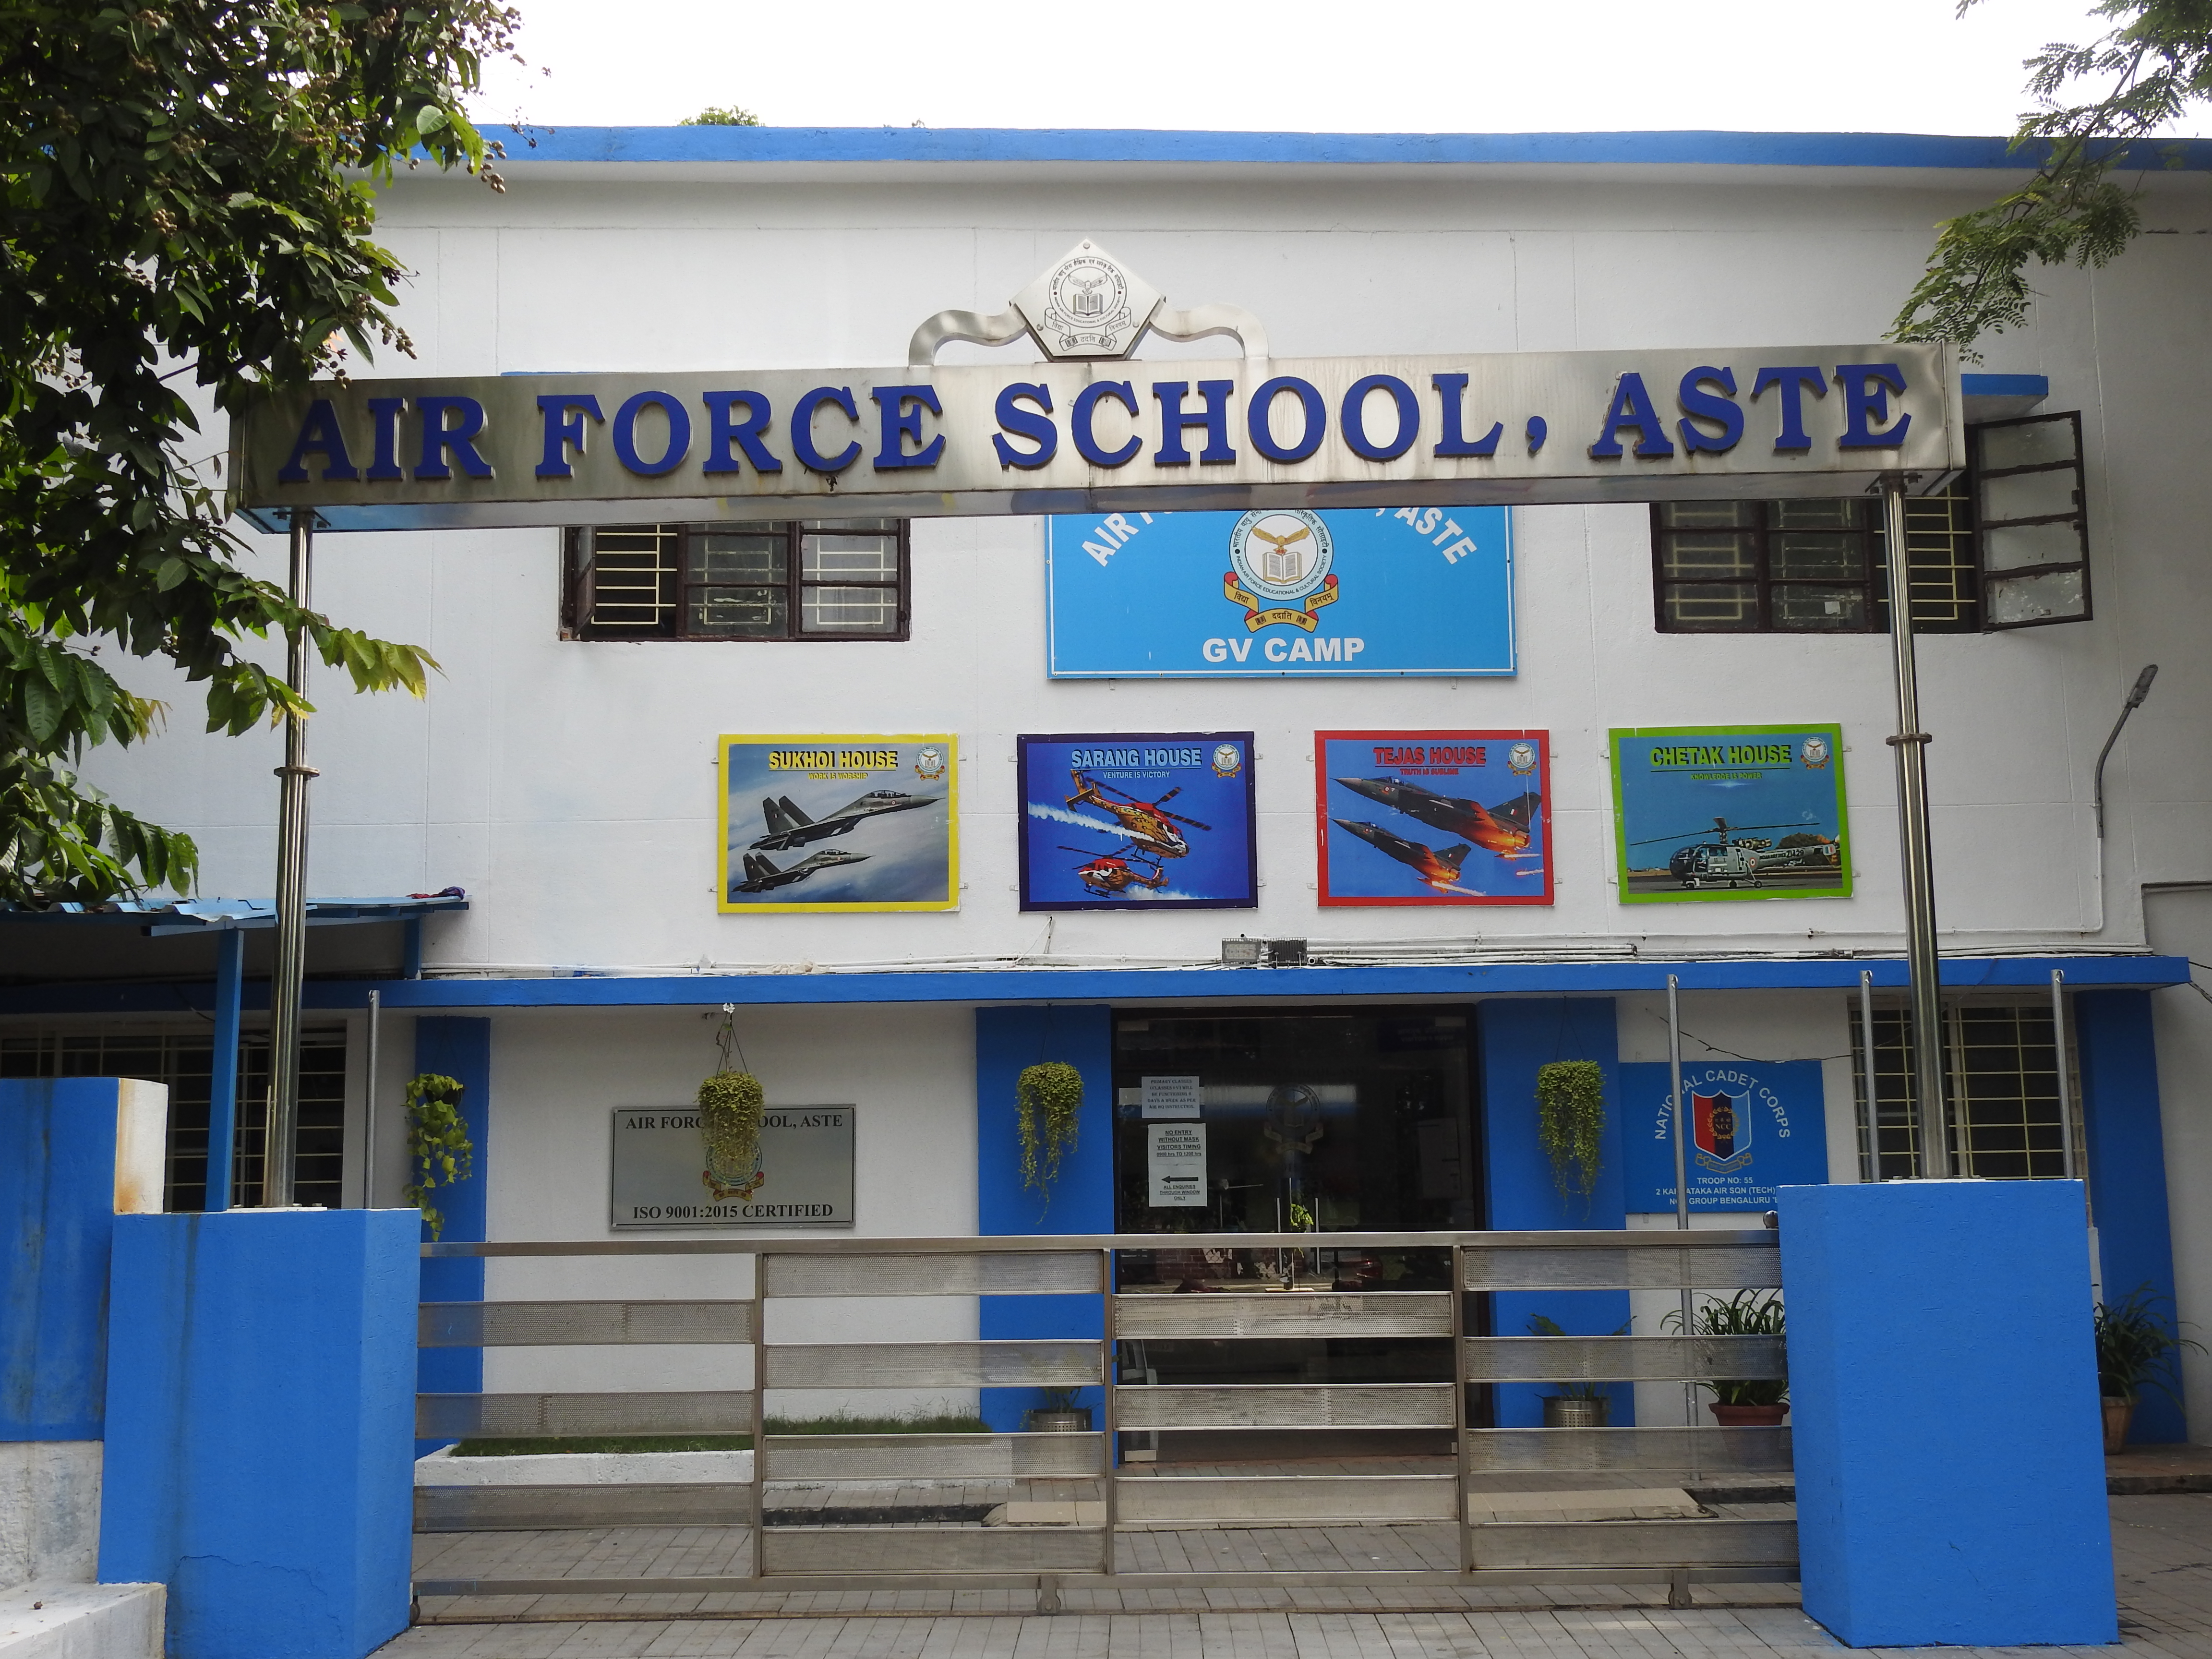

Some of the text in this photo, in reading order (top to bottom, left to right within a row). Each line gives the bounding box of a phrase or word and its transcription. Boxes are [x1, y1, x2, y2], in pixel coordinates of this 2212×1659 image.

[277, 363, 1911, 482] AIR FORCE SCHOOL, ASTE
[1082, 513, 1139, 567] AIR
[1394, 507, 1477, 565] ASTE
[1236, 555, 1245, 572] INDIAN
[1248, 577, 1262, 589] FORCE
[1262, 587, 1295, 595] EDUCATIONAL
[1299, 575, 1319, 591] CULTURAL
[1318, 555, 1327, 575] SOCIETY
[1234, 591, 1334, 620] विद्या ददाति विनयम्
[1202, 637, 1365, 663] GV CAMP
[769, 750, 835, 769] SUKHOI
[839, 750, 899, 769] HOUSE
[1071, 749, 1140, 767] SARANG
[1144, 748, 1202, 766] HOUSE
[1373, 747, 1486, 765] TEJAS HOUSE
[1650, 746, 1725, 766] CHETAK
[1729, 745, 1792, 764] HOUSE
[1655, 1070, 1791, 1139] NATIOAL CADET CORPS
[626, 1114, 842, 1129] AIR FORC OOL, ASTE
[1749, 1187, 1776, 1195] (TECH)
[633, 1204, 833, 1219] ISO 9001:2015 CERTIFIED
